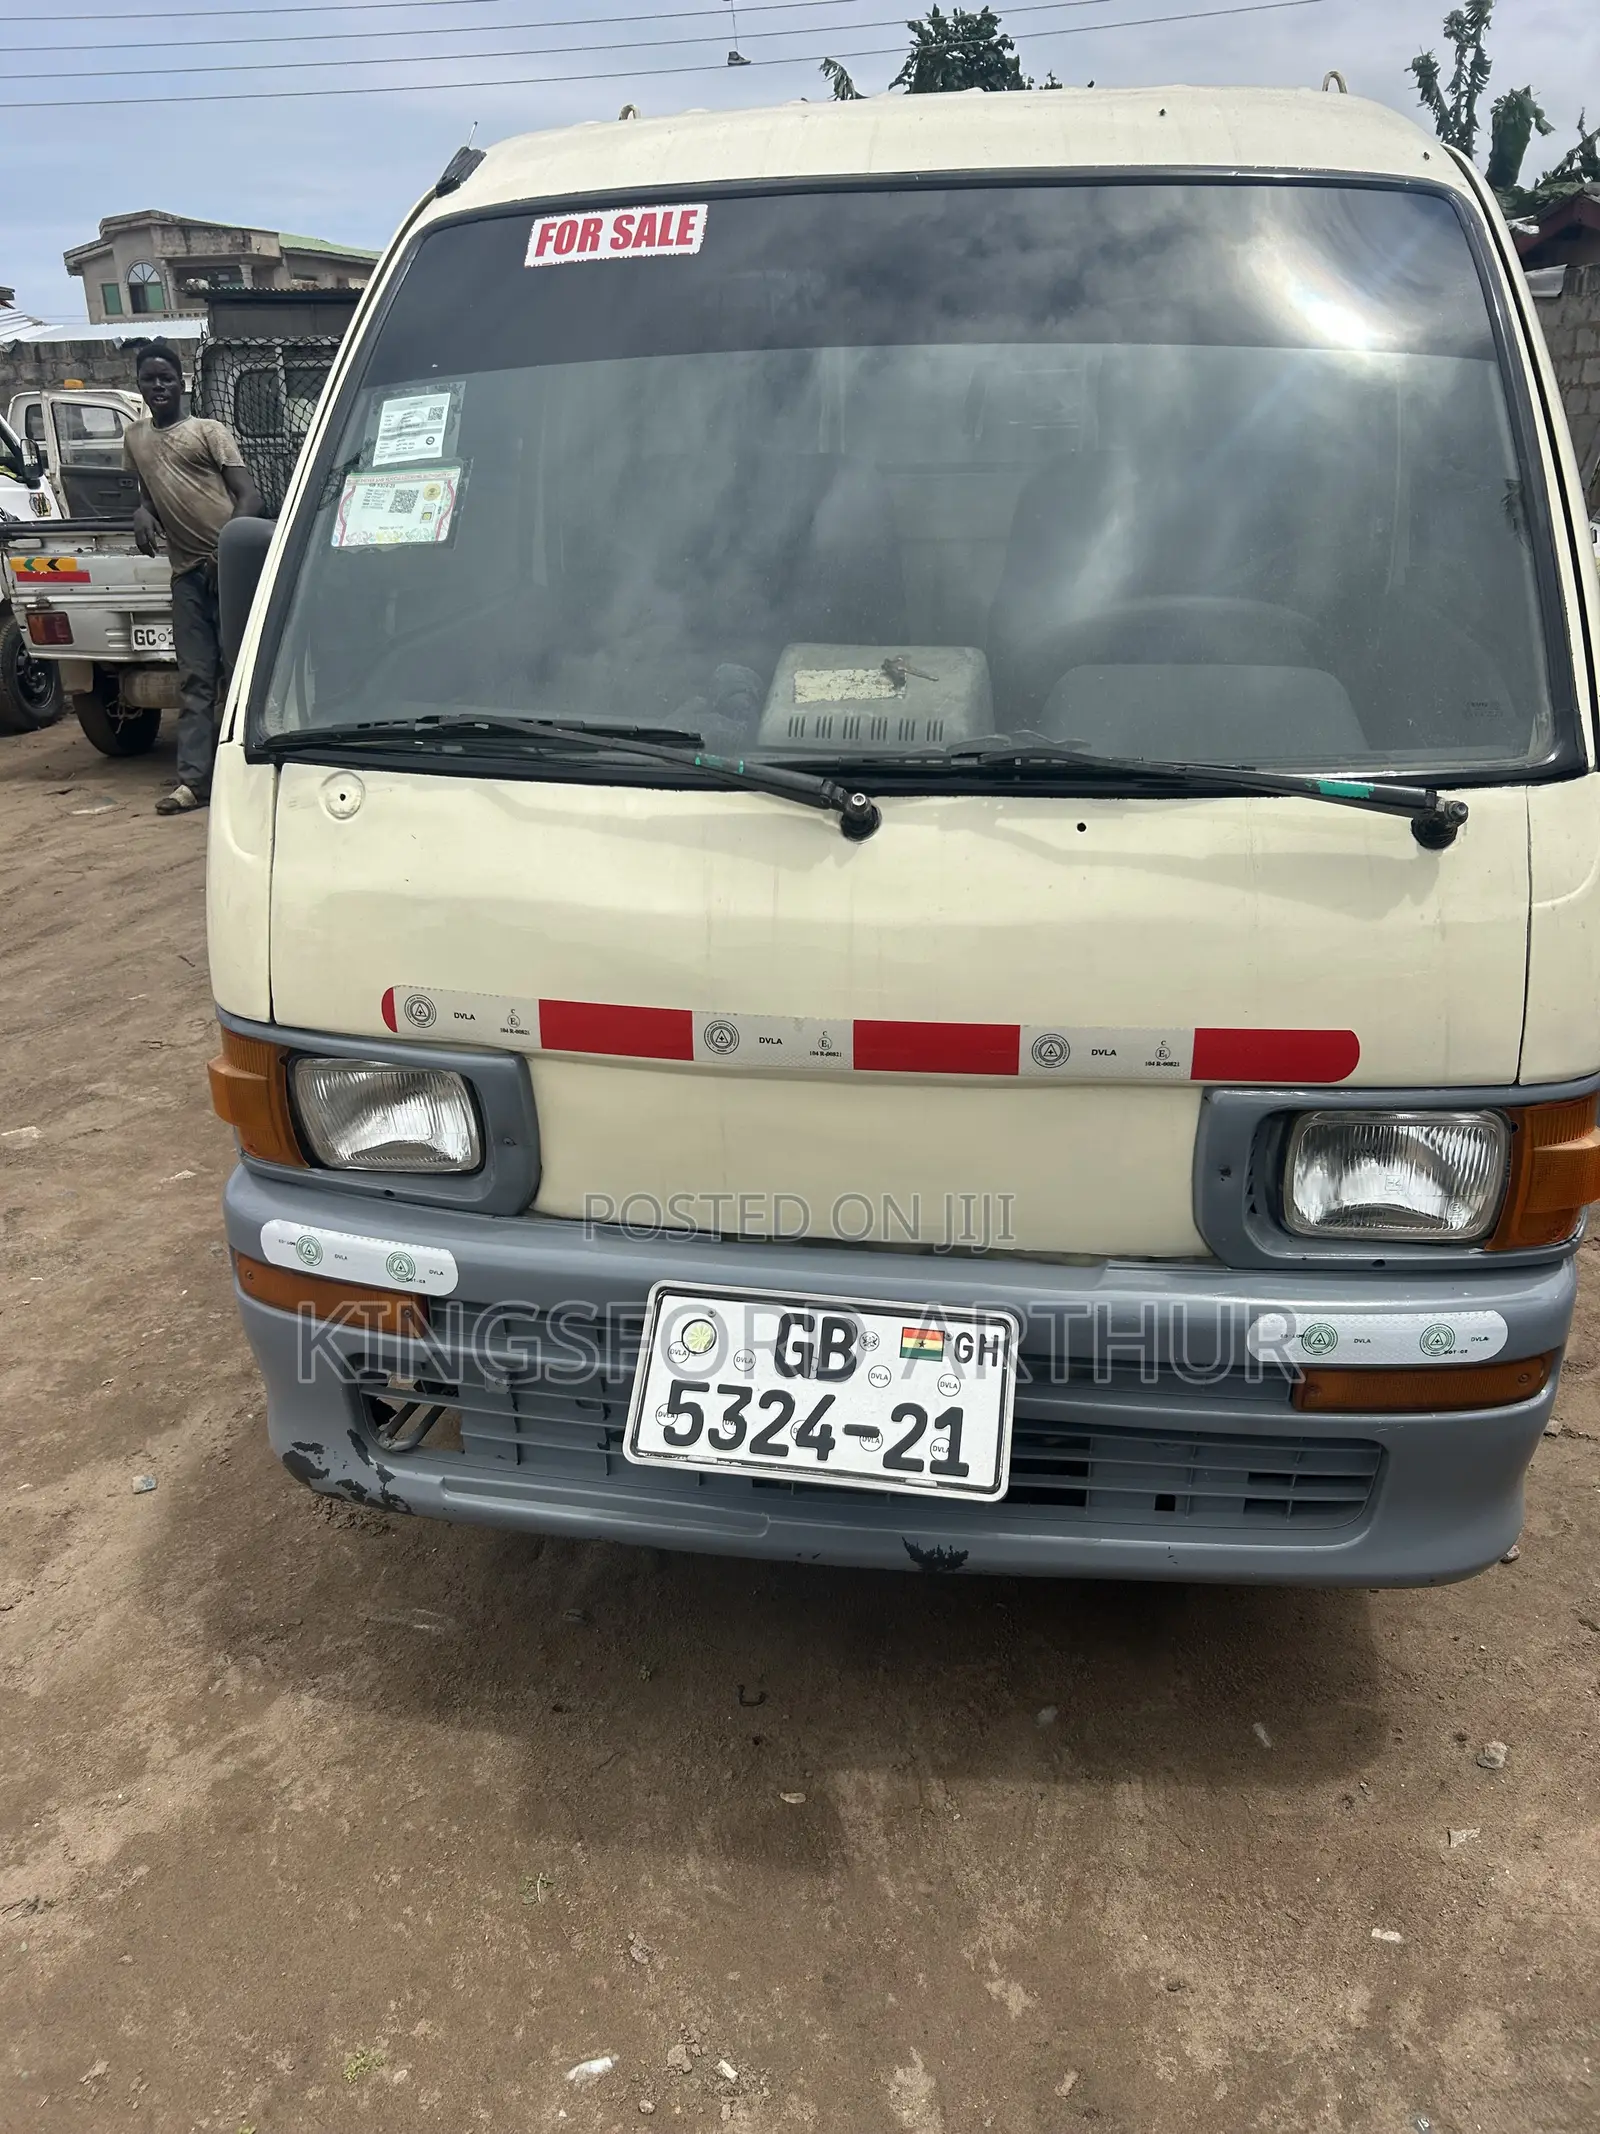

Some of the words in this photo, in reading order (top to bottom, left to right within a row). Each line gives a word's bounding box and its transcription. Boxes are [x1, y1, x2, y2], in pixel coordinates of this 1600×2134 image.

[534, 218, 603, 257] FOR
[609, 209, 698, 250] SALE
[134, 629, 157, 646] GC
[453, 1012, 476, 1021] DVLA
[758, 1037, 783, 1045] DVLA
[1091, 1049, 1117, 1057] DVLA
[334, 1253, 348, 1261] DVLA
[669, 1348, 687, 1356] DVLA
[773, 1313, 858, 1382] GB
[954, 1331, 1000, 1367] GH
[736, 1356, 754, 1365] DVLA
[870, 1372, 889, 1382] DVLA
[939, 1381, 958, 1390] DVLA
[663, 1379, 970, 1477] 5324-21
